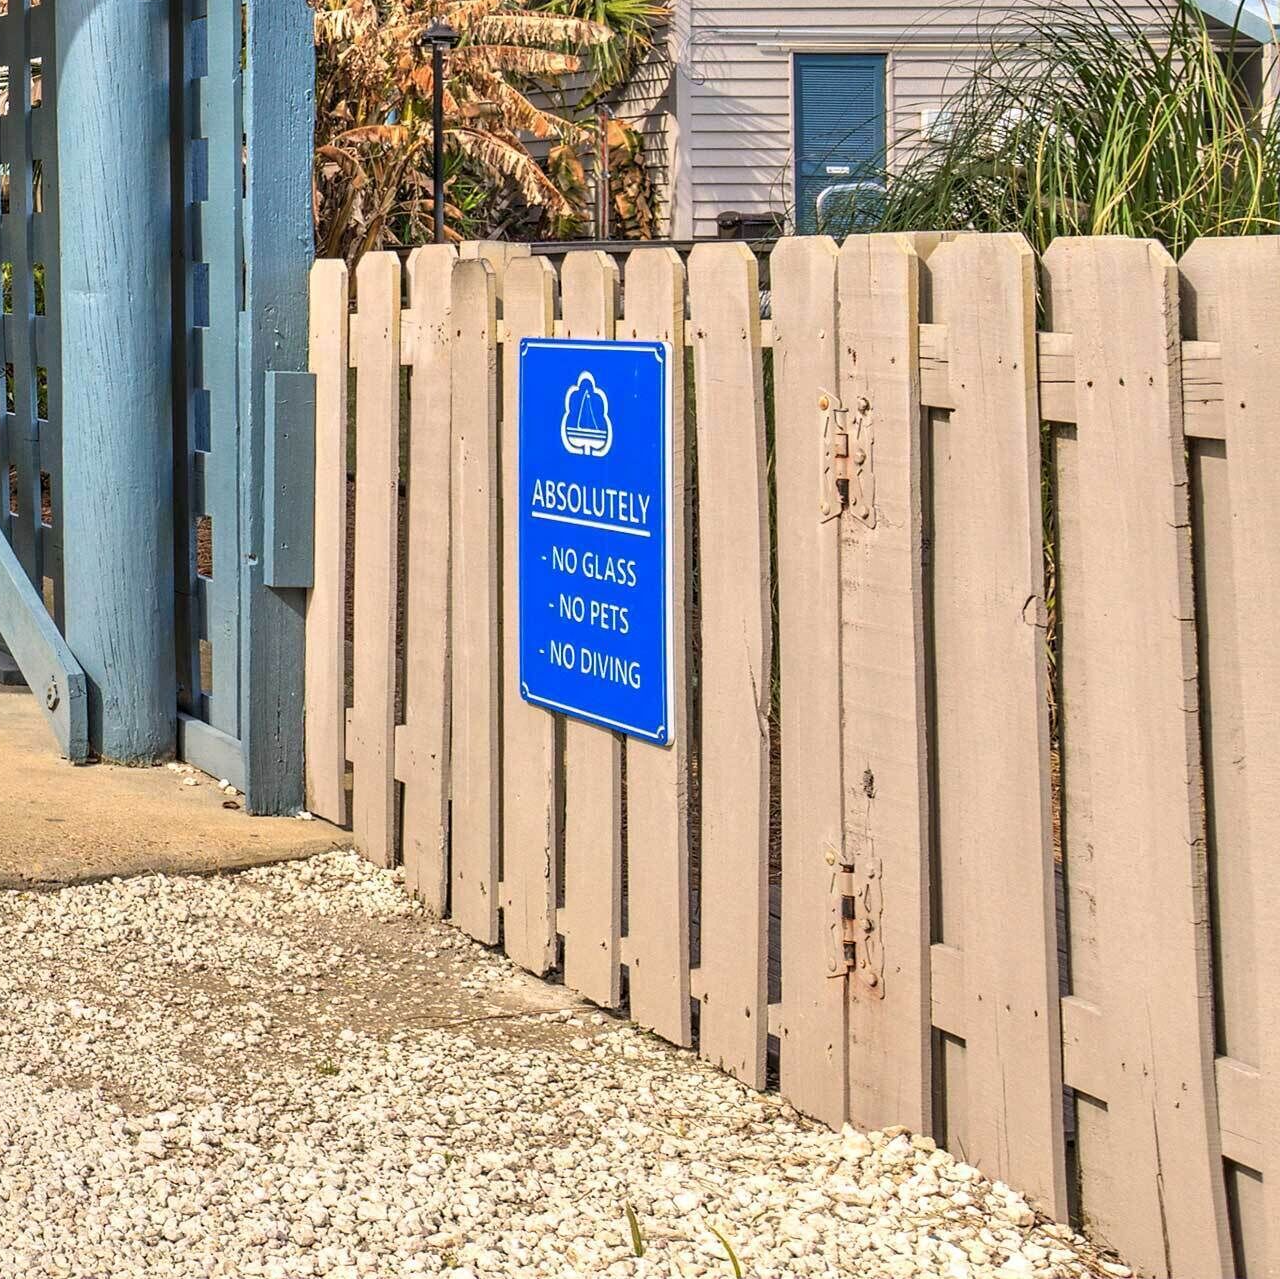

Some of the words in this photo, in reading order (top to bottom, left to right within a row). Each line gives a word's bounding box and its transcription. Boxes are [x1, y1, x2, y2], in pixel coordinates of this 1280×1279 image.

[531, 478, 651, 525] ABSOLUTELY
[552, 545, 578, 575] NO
[582, 551, 638, 588] GLASS
[559, 593, 585, 623] NO
[590, 600, 630, 635] PETS
[550, 639, 576, 670] NO
[580, 647, 641, 690] DIVING
